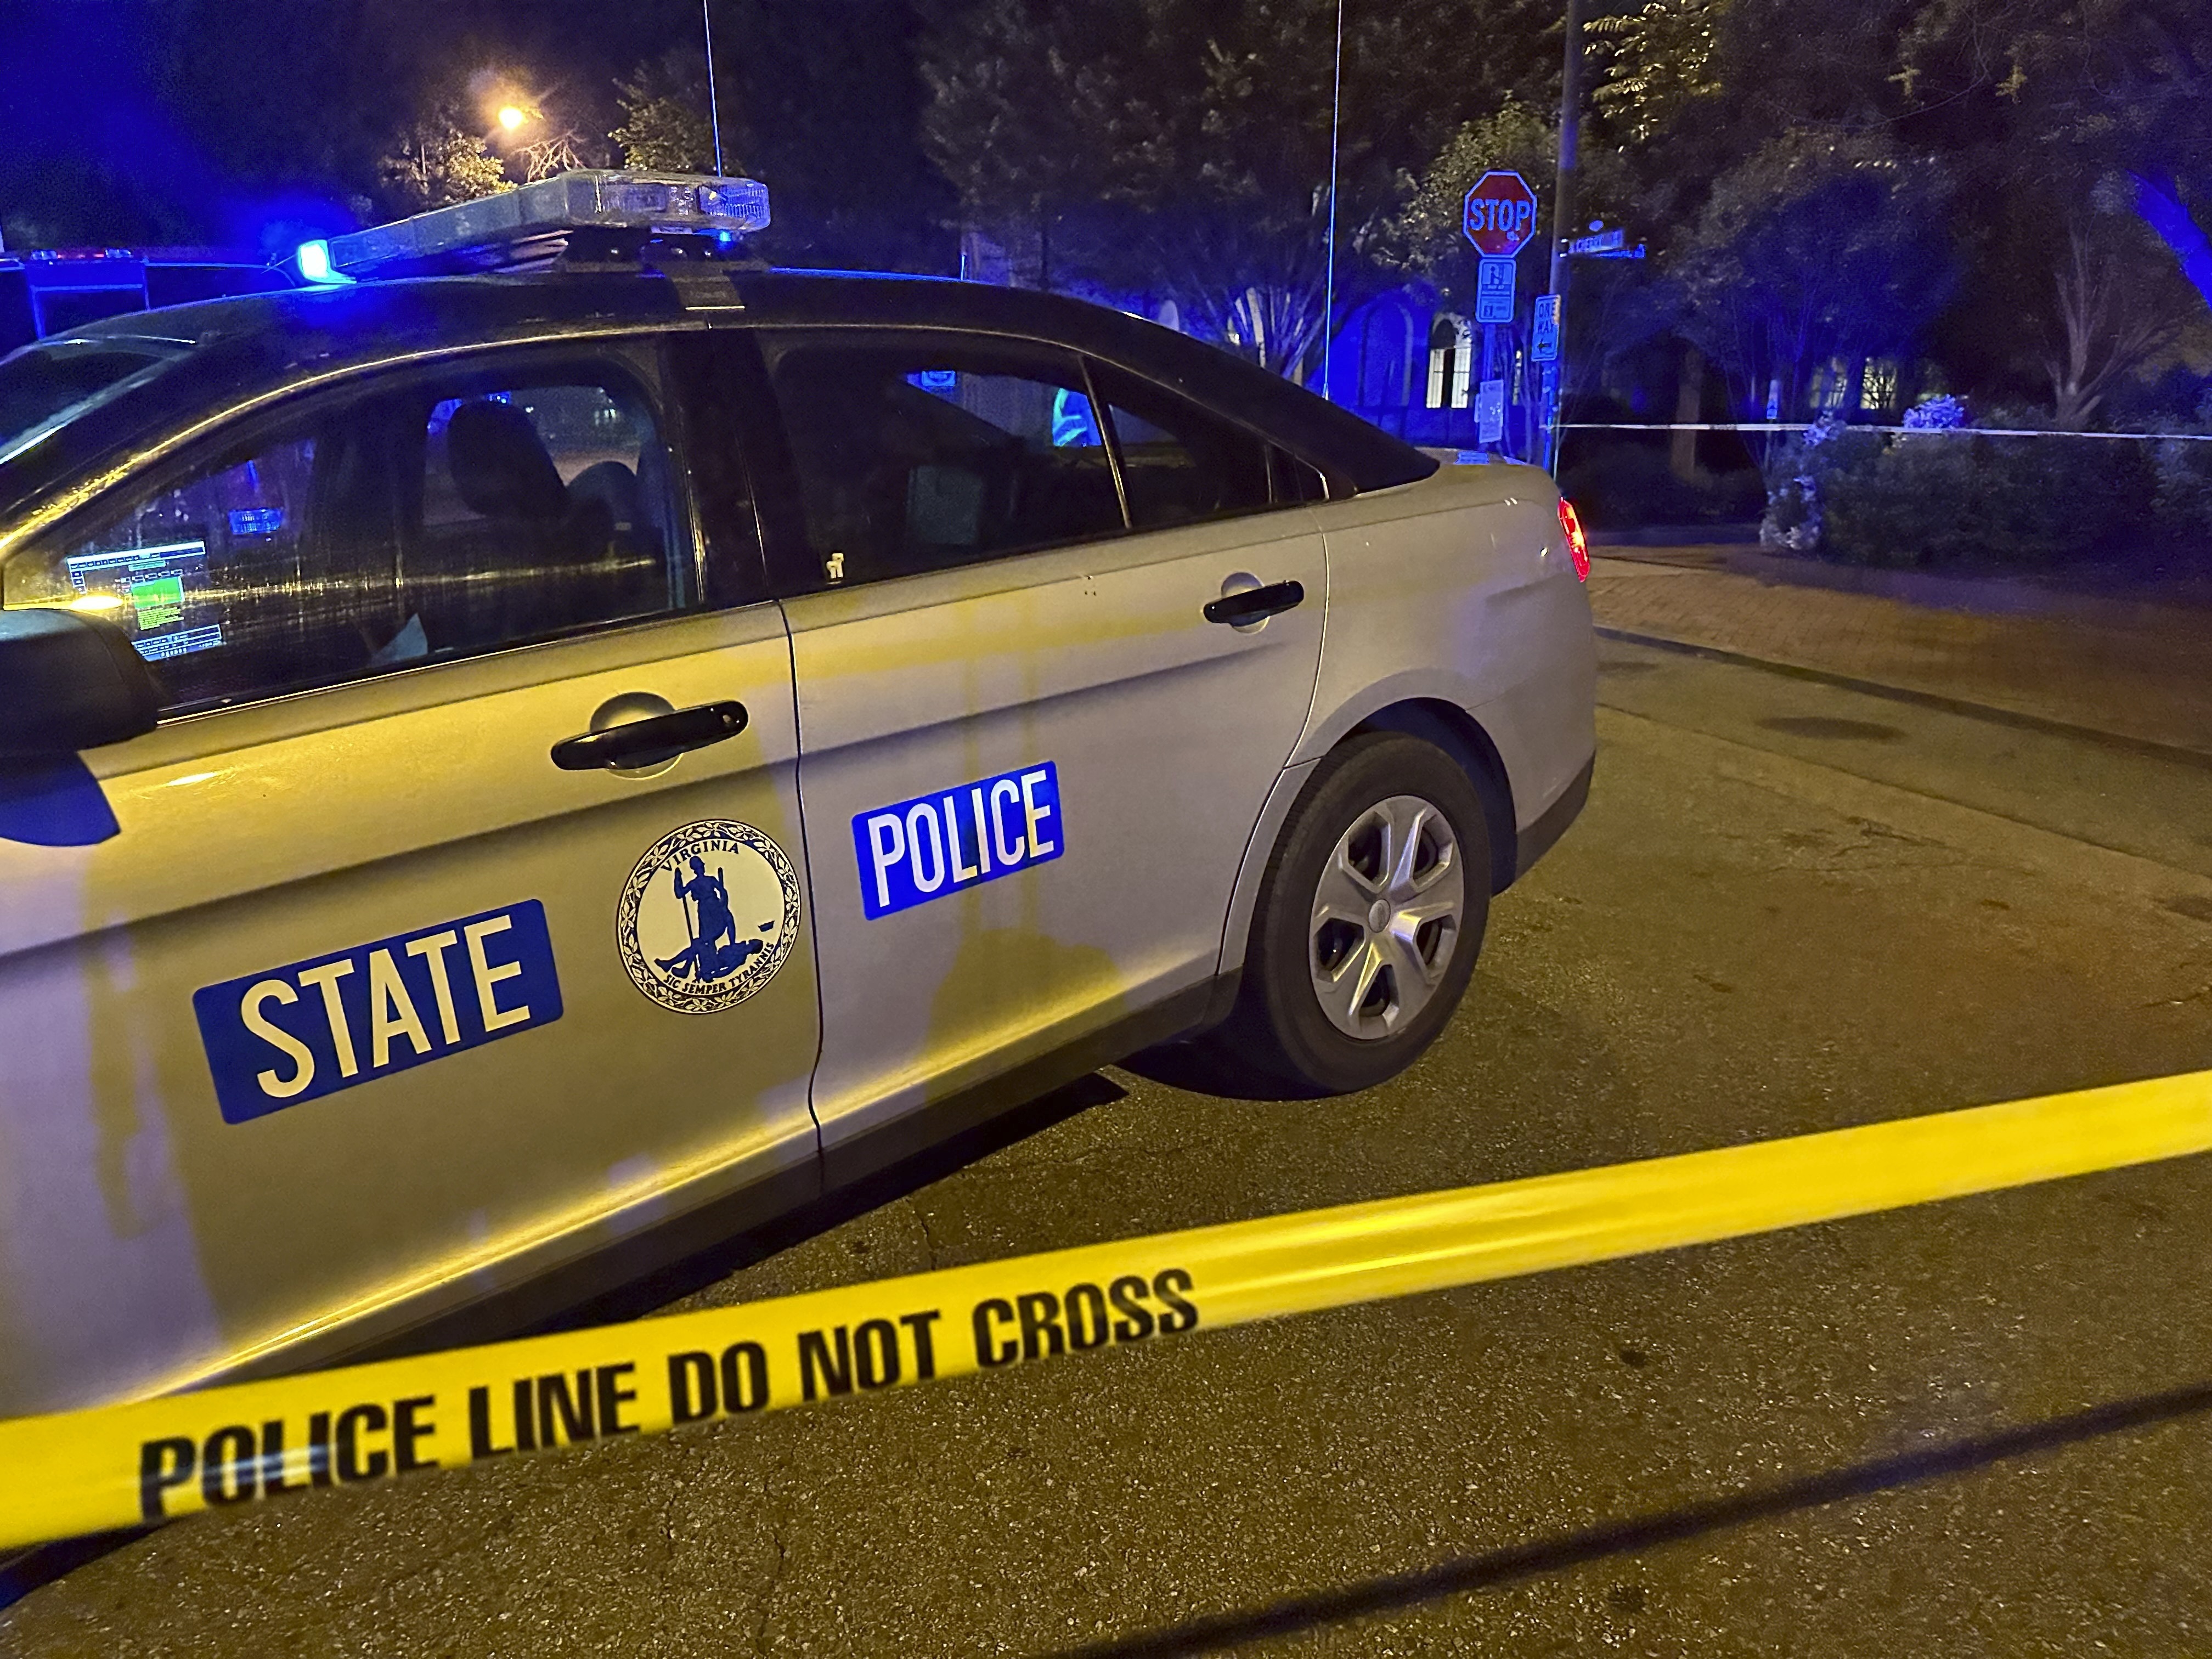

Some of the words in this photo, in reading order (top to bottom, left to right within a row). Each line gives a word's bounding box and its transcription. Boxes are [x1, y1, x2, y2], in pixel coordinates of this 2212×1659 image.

[1469, 199, 1531, 231] STOP
[1538, 302, 1556, 318] ONE
[1538, 320, 1554, 335] WAY
[661, 840, 740, 872] VIRGINIA
[867, 769, 1054, 908] POLICE
[663, 973, 681, 989] SIC
[682, 981, 726, 995] SEMPER
[730, 942, 775, 988] TYRANNIS
[240, 915, 531, 1098] STATE
[139, 1395, 439, 1523] POLICE
[469, 1362, 640, 1459] LINE
[667, 1341, 769, 1424] DO
[797, 1310, 941, 1402] NOT
[972, 1267, 1199, 1370] CROSS
